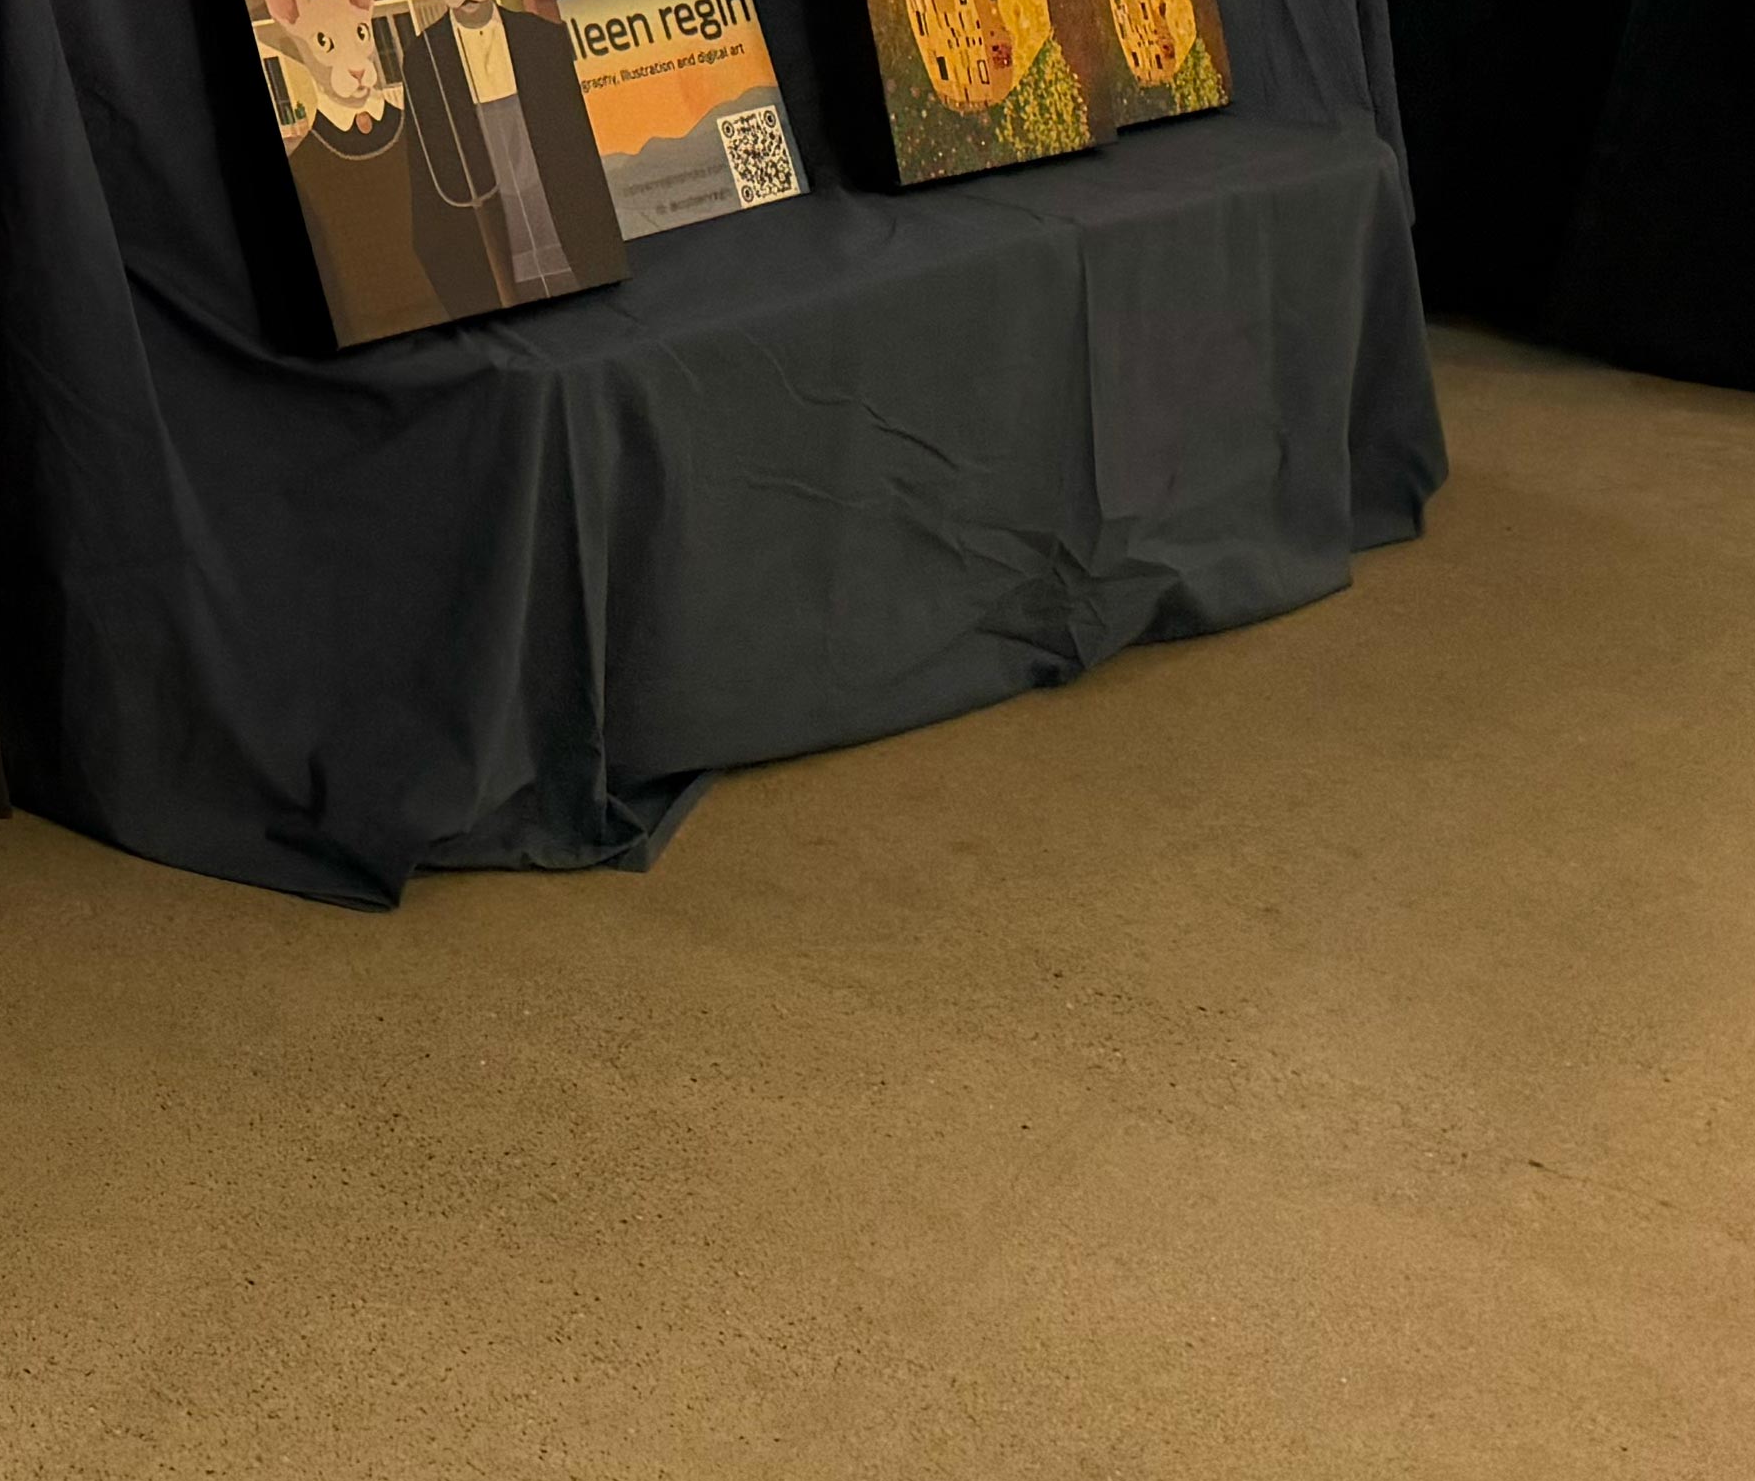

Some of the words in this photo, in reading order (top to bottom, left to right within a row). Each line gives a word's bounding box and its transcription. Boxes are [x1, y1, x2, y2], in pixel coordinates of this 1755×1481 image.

[571, 12, 654, 61] leen
[621, 60, 676, 82] illustration
[677, 54, 696, 68] and
[697, 46, 728, 64] digital
[730, 43, 745, 55] art
